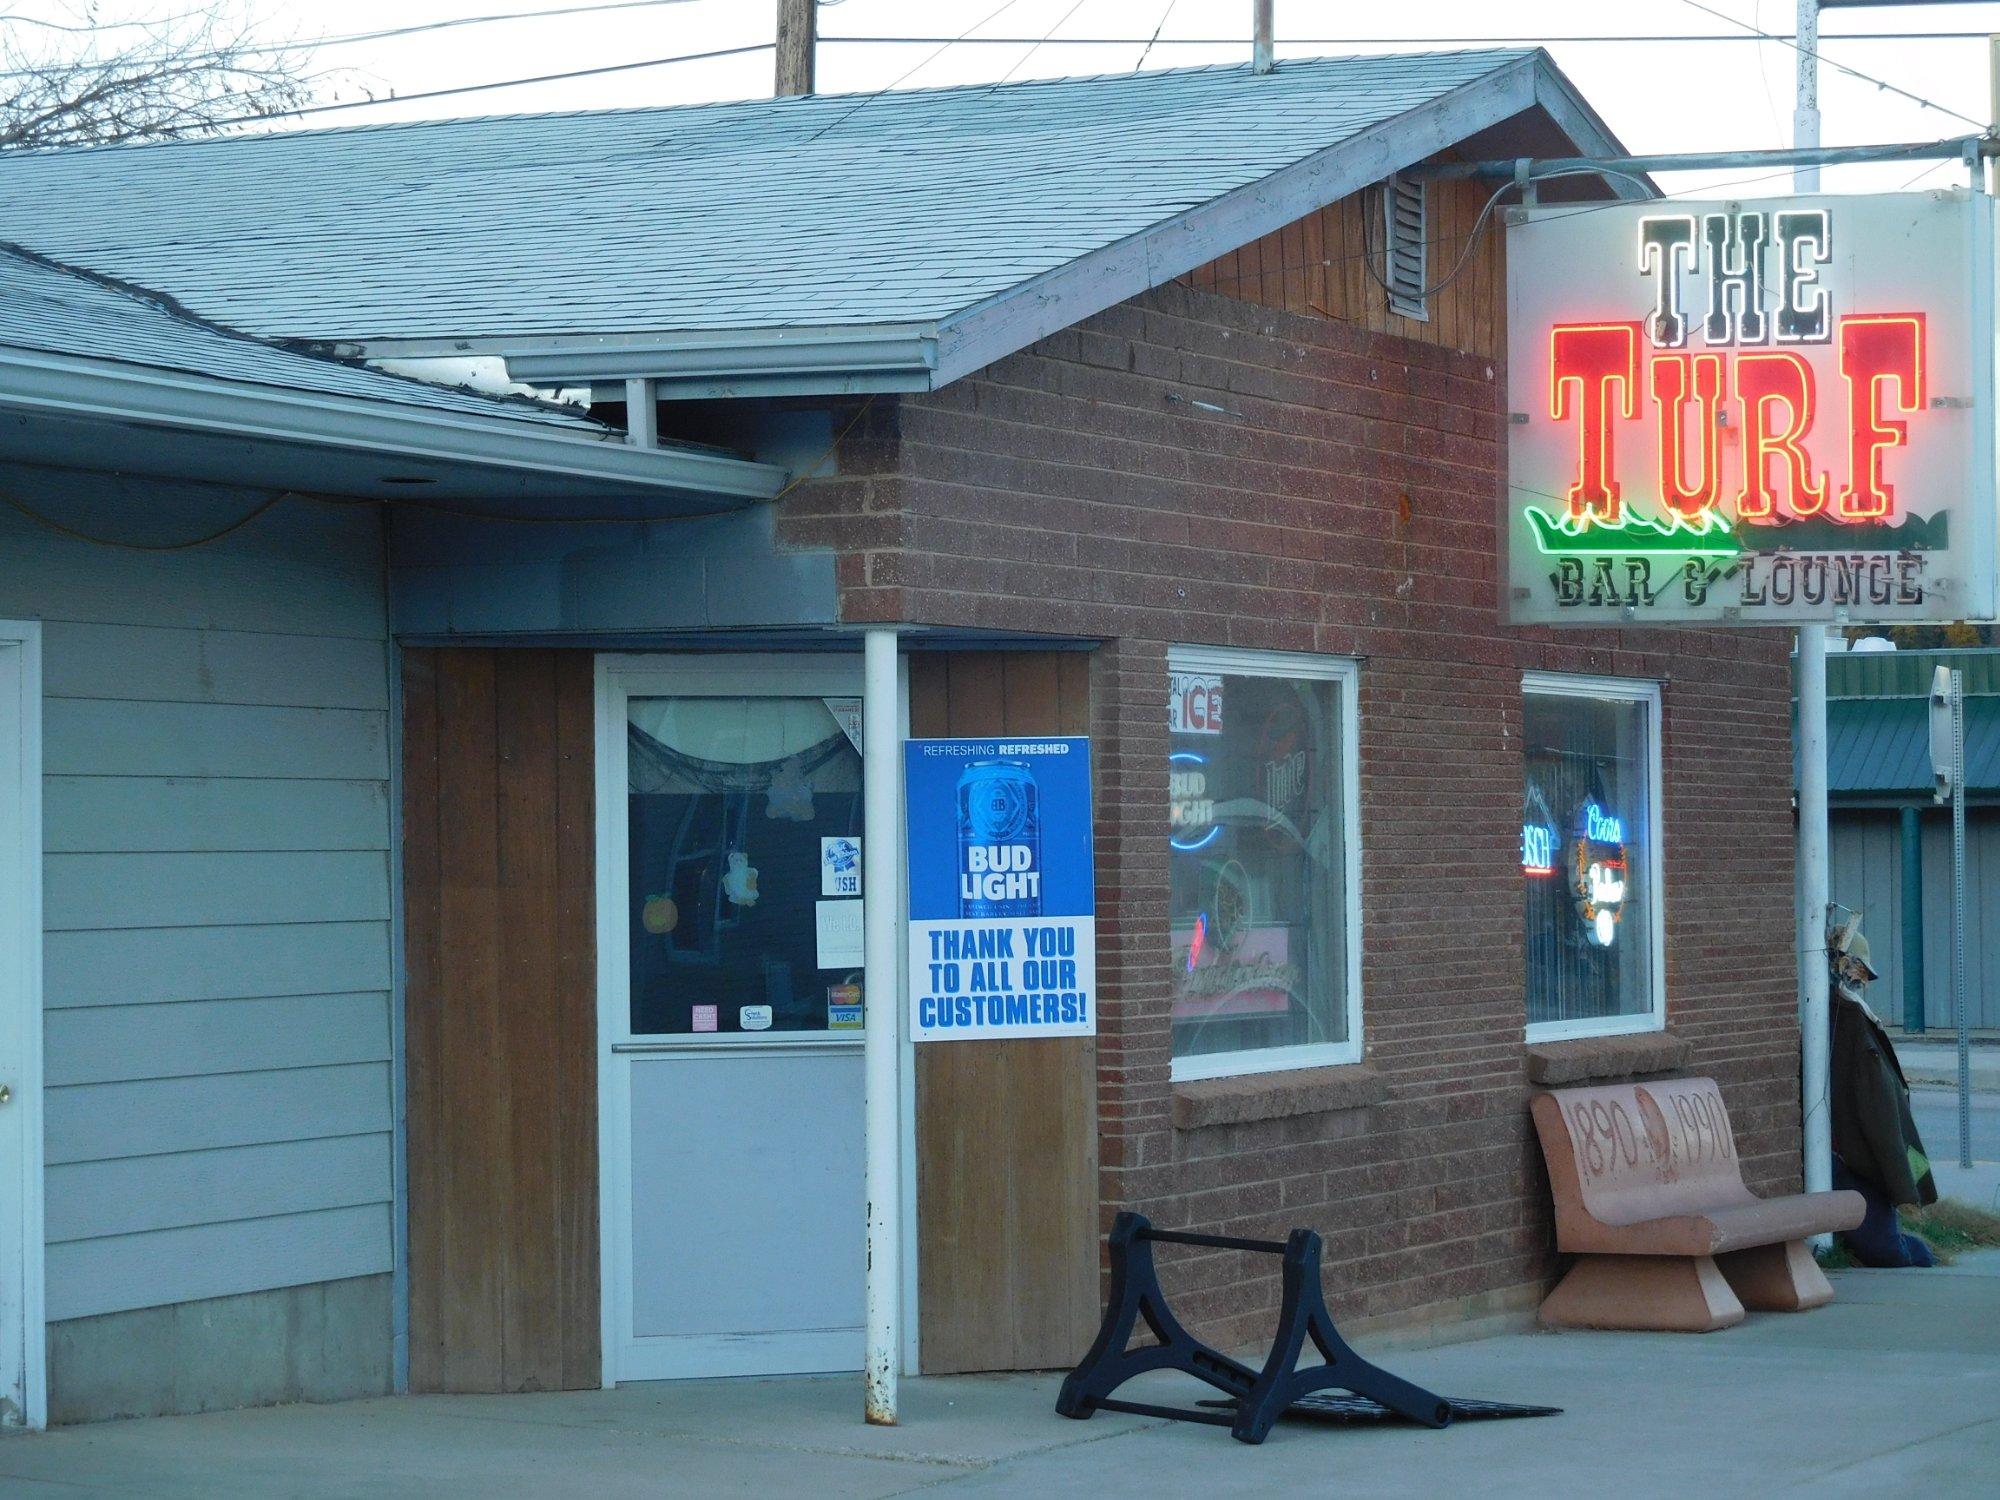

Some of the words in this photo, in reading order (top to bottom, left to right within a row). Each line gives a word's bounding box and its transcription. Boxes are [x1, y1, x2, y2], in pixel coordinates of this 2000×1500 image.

[1637, 209, 1832, 348] THE
[1549, 312, 1927, 530] TURF
[1556, 556, 1654, 607] BAR
[1681, 556, 1709, 607] &
[1738, 554, 1923, 607] LOUNGE
[1182, 685, 1223, 730] ICE
[923, 745, 995, 756] REFRESHING
[999, 743, 1070, 755] REFRESHED
[1587, 804, 1622, 843] Coors
[968, 845, 1032, 872] BUD
[961, 872, 1040, 901] LIGHT
[928, 928, 1014, 960] THANK
[1023, 926, 1075, 957] YOU
[928, 963, 960, 993] TO
[970, 961, 1012, 992] ALL
[1023, 960, 1076, 991] OUR
[836, 1013, 856, 1022] VISA
[919, 992, 1087, 1028] CUSTOMERS!
